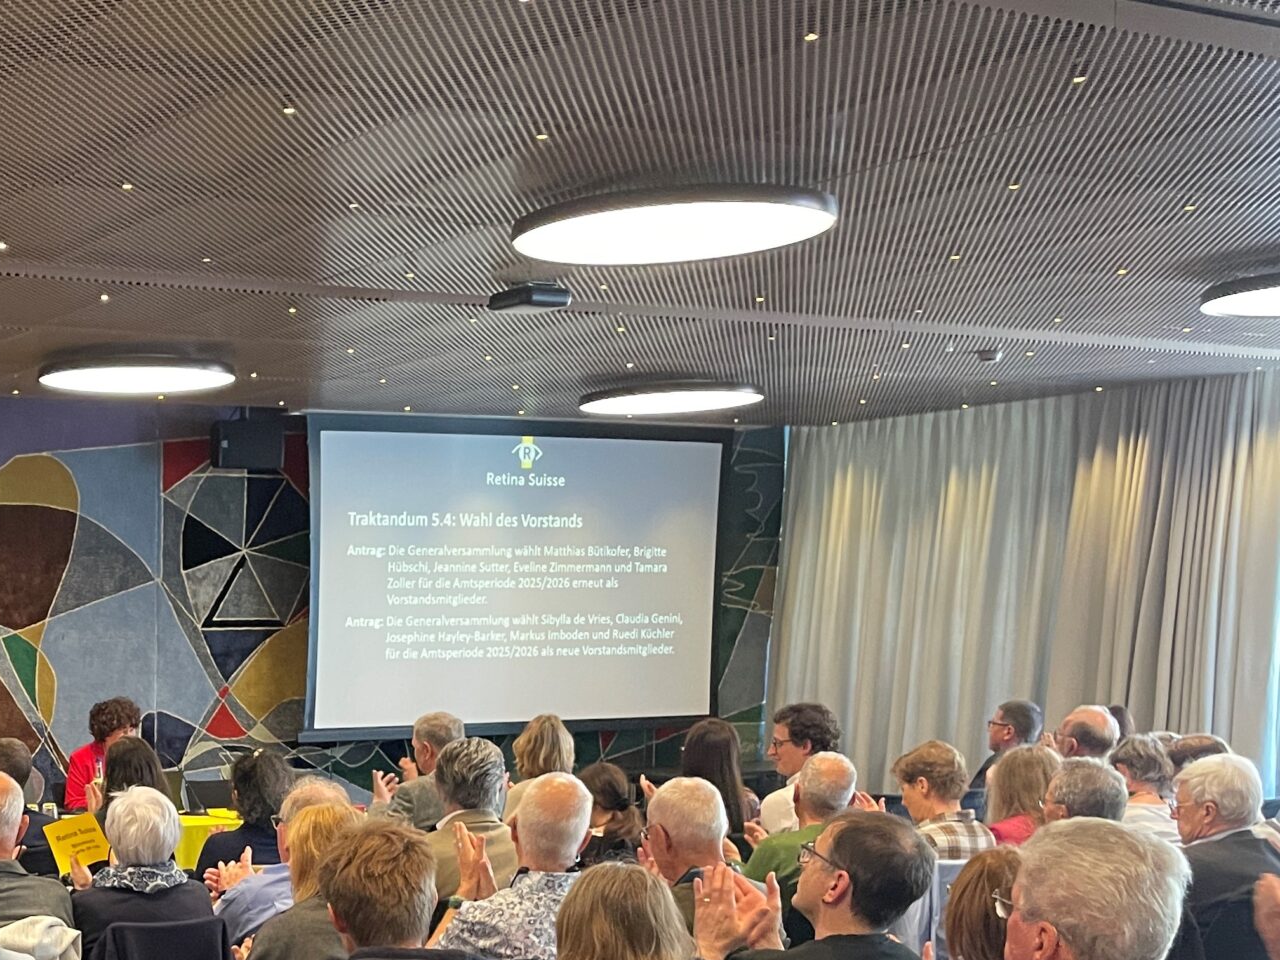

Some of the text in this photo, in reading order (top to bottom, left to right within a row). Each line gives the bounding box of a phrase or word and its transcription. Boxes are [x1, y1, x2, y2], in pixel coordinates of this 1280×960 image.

[487, 473, 565, 486] Retina Suisse
[348, 511, 583, 528] Traktandum 5.4: Wahl des Vorstands
[347, 545, 666, 559] Antrag: Die Generalversammlung wählt Matthias Bütikofer, Brigitte
[388, 562, 667, 574] Hübschi, Jeannine Sutter, Eveline Zimmermann und Tamara
[387, 577, 618, 590] Zoller für die Amtsperiode 2025/2026 erneut als
[387, 594, 488, 606] Vorstandsmitglieder.
[345, 613, 683, 629] Antrag: Die Generalversammlung wählt Sibylla de Vries, Claudia Genini,
[386, 628, 674, 644] Josephine Hayley-Barker, Markus Imboden und Ruedi Küchler
[386, 645, 675, 660] für die Amtsperiode 2025/2026 als neue Vorstandsmitglieder.
